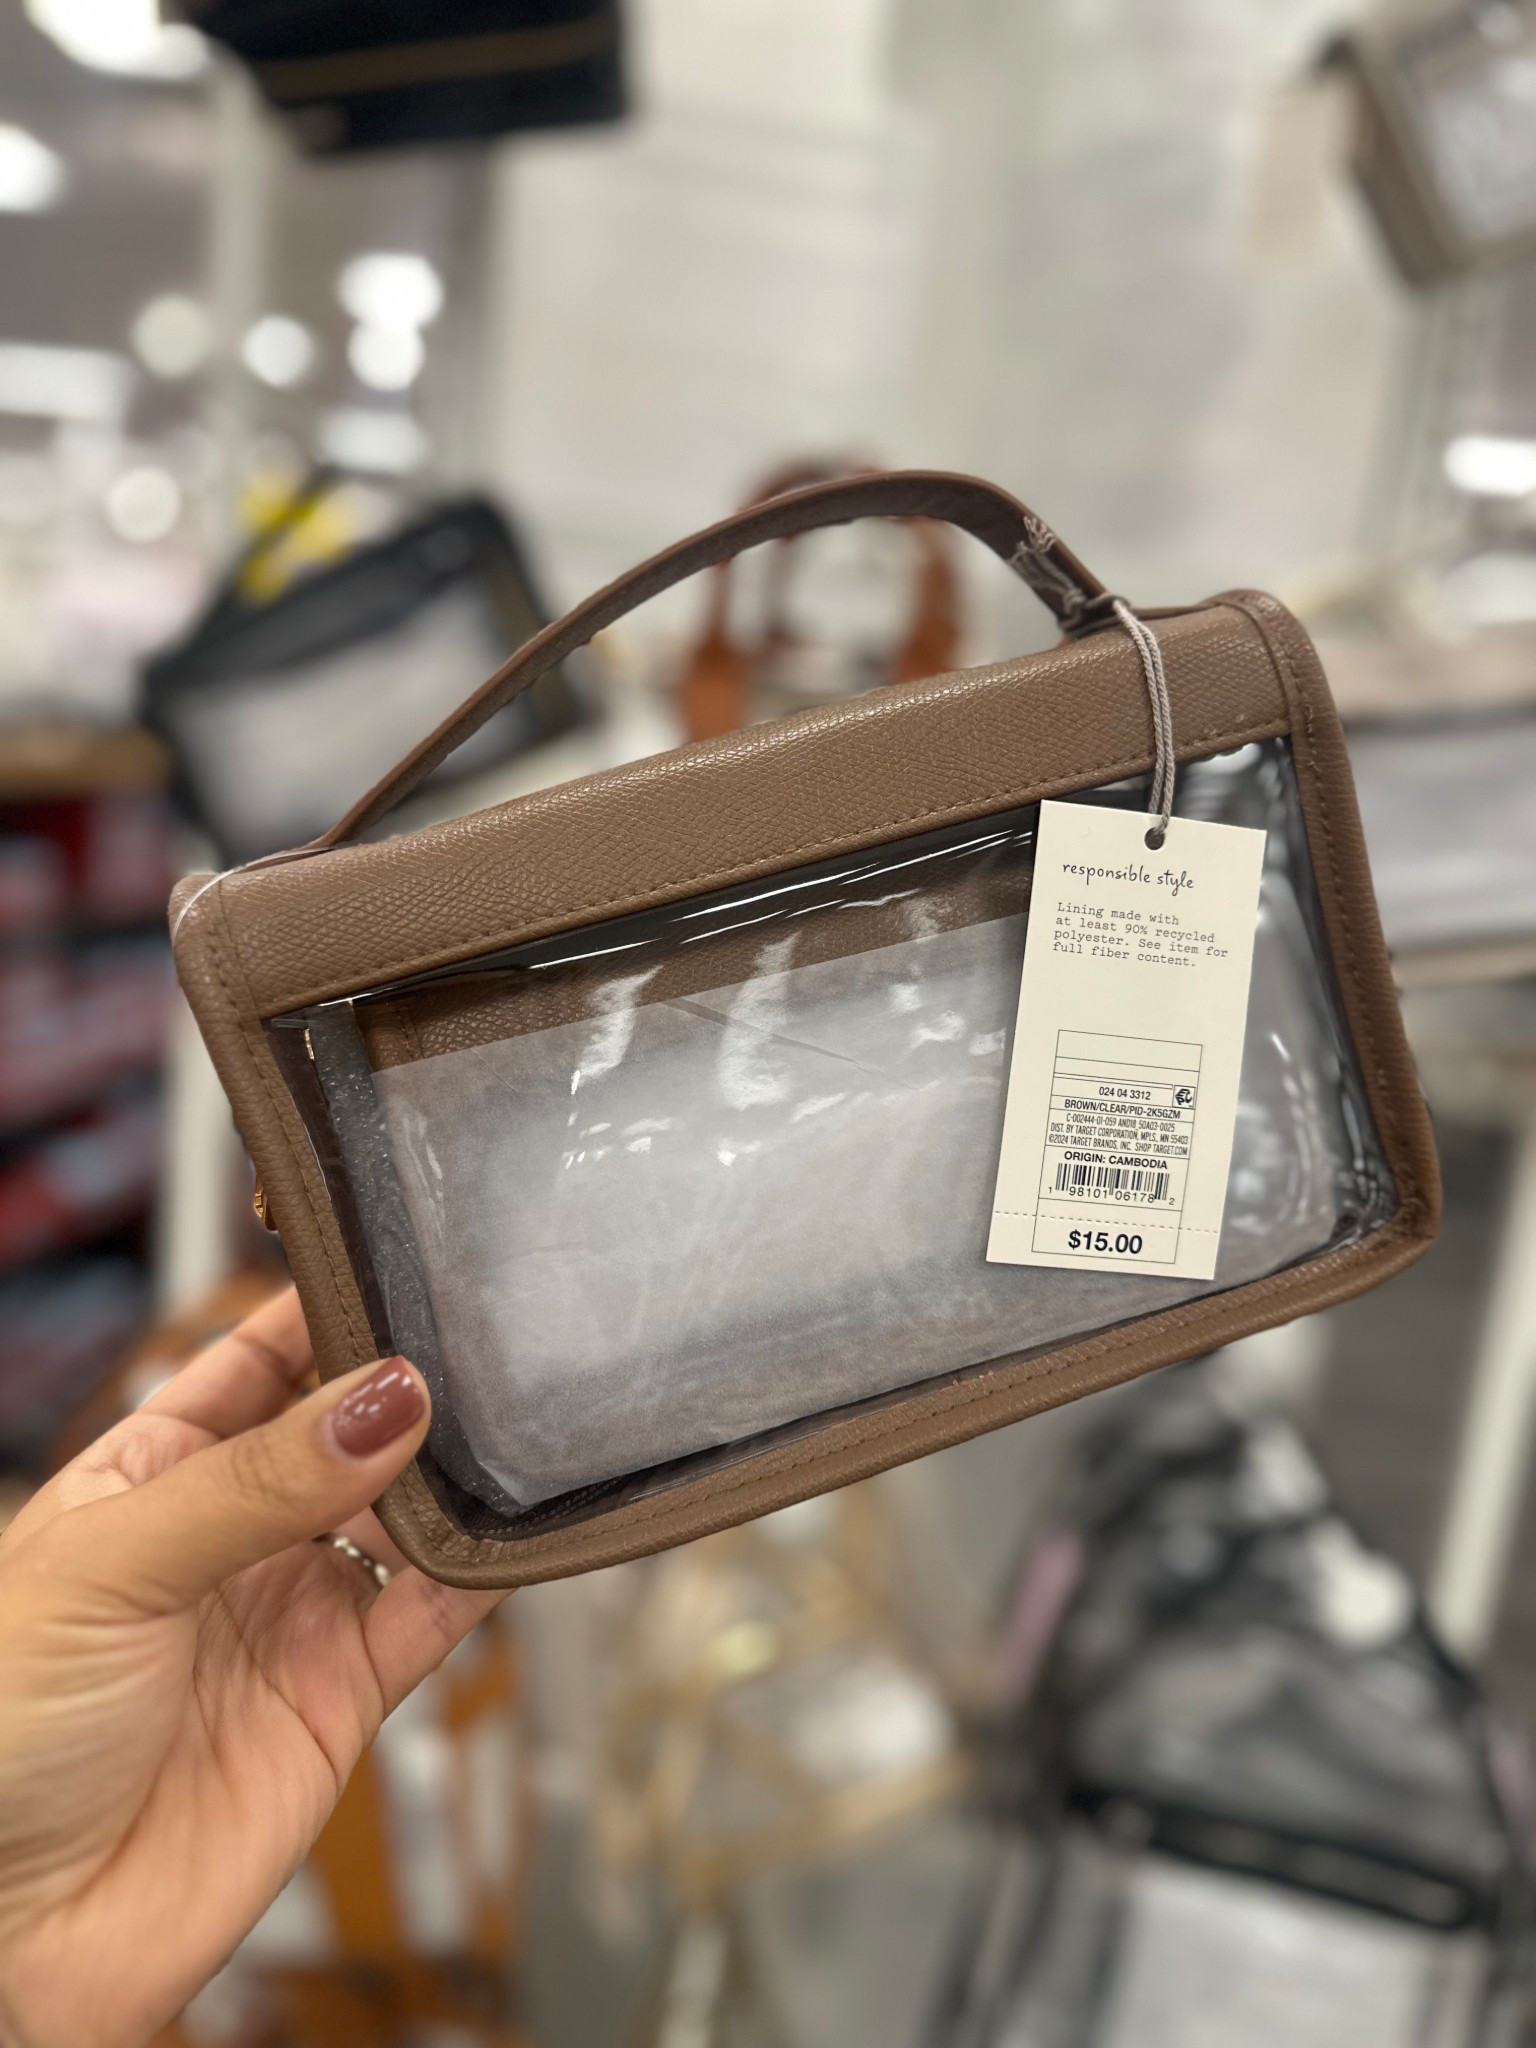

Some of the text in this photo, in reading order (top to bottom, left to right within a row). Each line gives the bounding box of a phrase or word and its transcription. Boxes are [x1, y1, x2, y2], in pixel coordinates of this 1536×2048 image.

[1062, 863, 1194, 896] responsible style
[1057, 902, 1179, 925] Lining made with
[1056, 917, 1214, 943] at least 90% recycled
[1053, 942, 1196, 966] full fiber content.
[1054, 930, 1228, 958] polyester. See item for
[1099, 1087, 1151, 1100] 024 04 3312
[1064, 1099, 1181, 1119] BROWN/CLEAR/PID-2K5GZM
[1066, 1113, 1117, 1126] C-002444-01-059
[1051, 1122, 1064, 1132] DIST.
[1066, 1124, 1073, 1133] BY
[1075, 1125, 1097, 1135] TARGET
[1160, 1133, 1169, 1142] MN
[1170, 1135, 1188, 1144] 55403
[1070, 1136, 1091, 1146] TARGET
[1093, 1138, 1117, 1149] BRANDS,
[1120, 1141, 1132, 1150] INC.
[1135, 1143, 1151, 1152] SHOP
[1153, 1144, 1188, 1156] TARGET.COM
[1064, 1151, 1168, 1170] ORIGIN: CAMBODIA
[1068, 1229, 1143, 1254] $15.00
